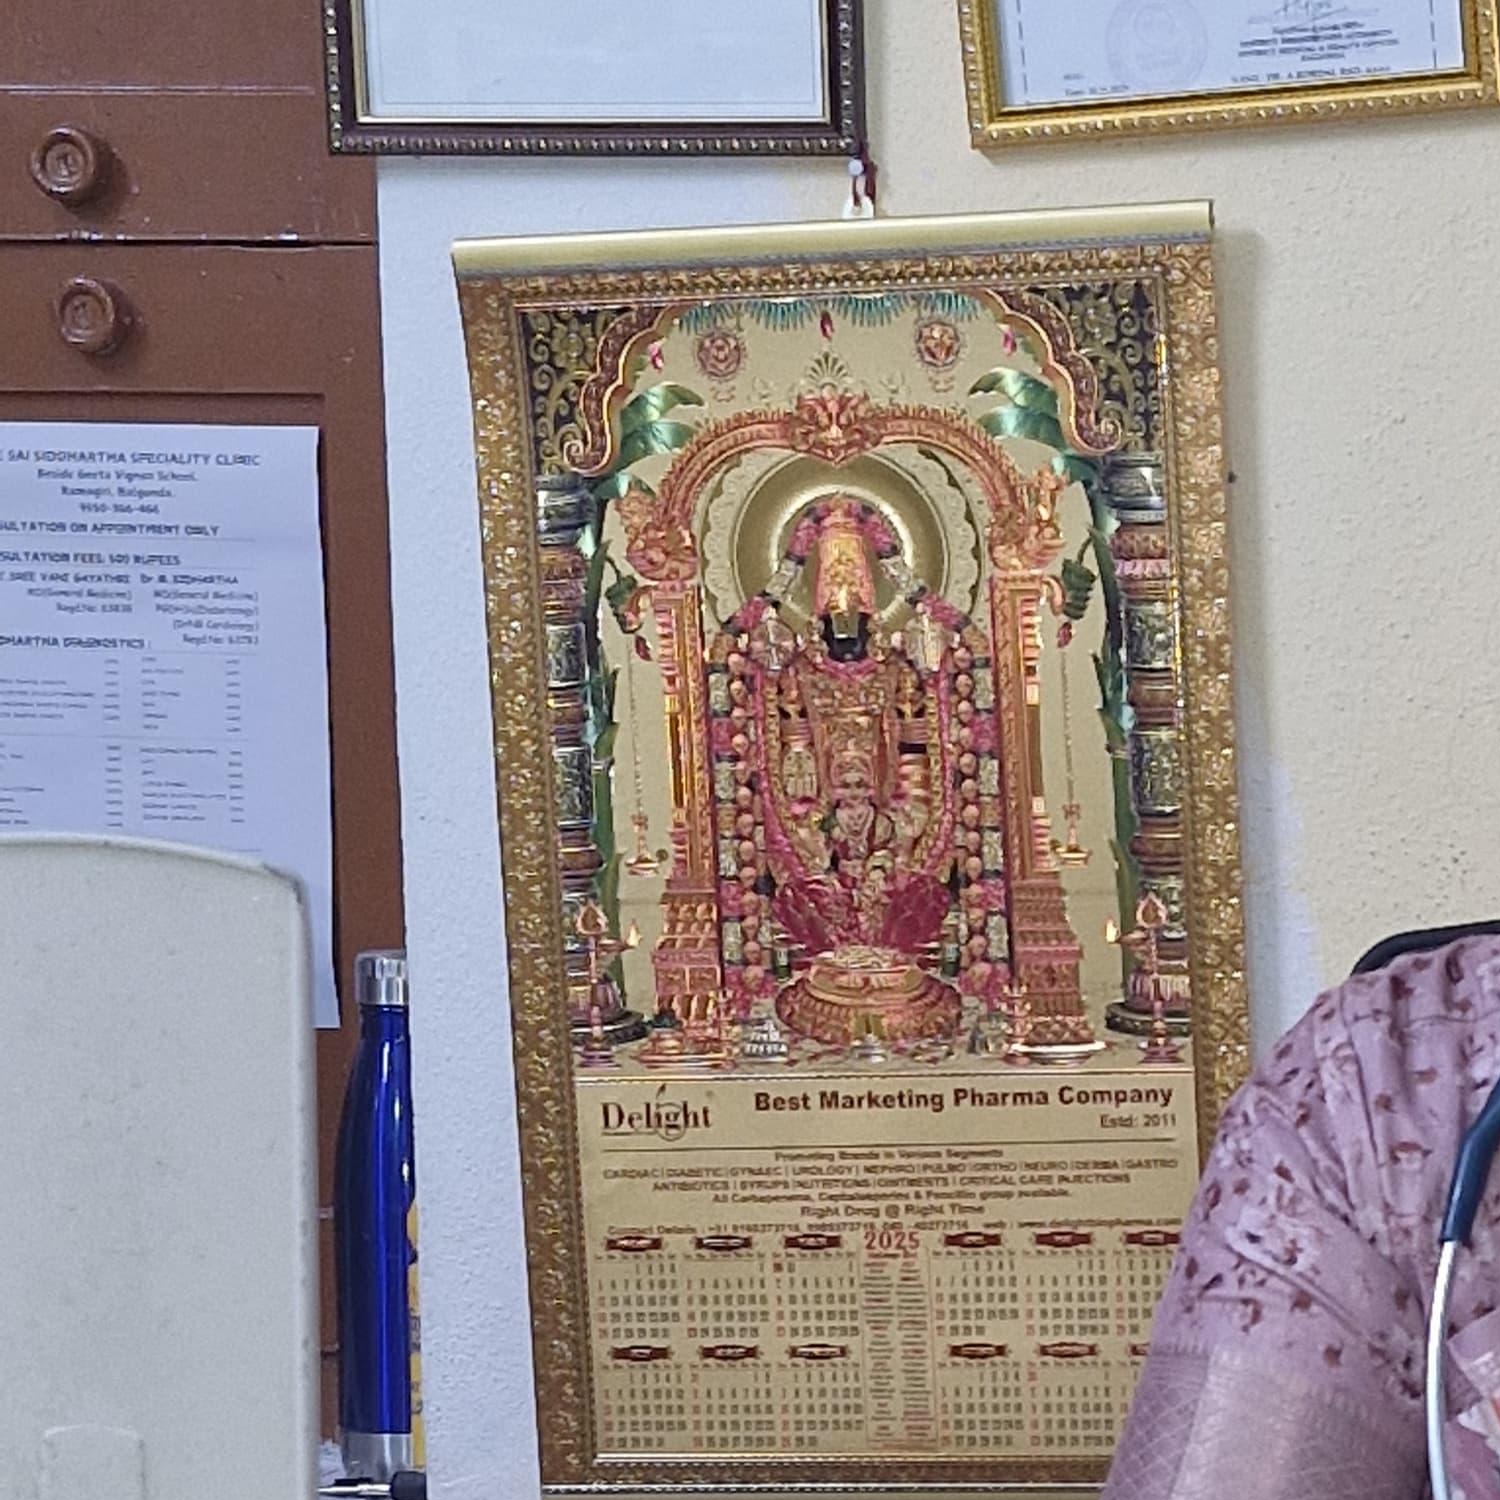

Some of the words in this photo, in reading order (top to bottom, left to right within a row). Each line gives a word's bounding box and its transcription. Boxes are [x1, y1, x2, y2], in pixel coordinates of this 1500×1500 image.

[8, 449, 29, 461] SAI
[754, 1091, 812, 1111] Best
[819, 1089, 945, 1113] Marketing
[953, 1087, 1049, 1108] Pharma
[1058, 1085, 1174, 1108] Company
[601, 1100, 712, 1140] Delight
[1143, 1112, 1177, 1127] 2011
[864, 1231, 920, 1250] 2025
